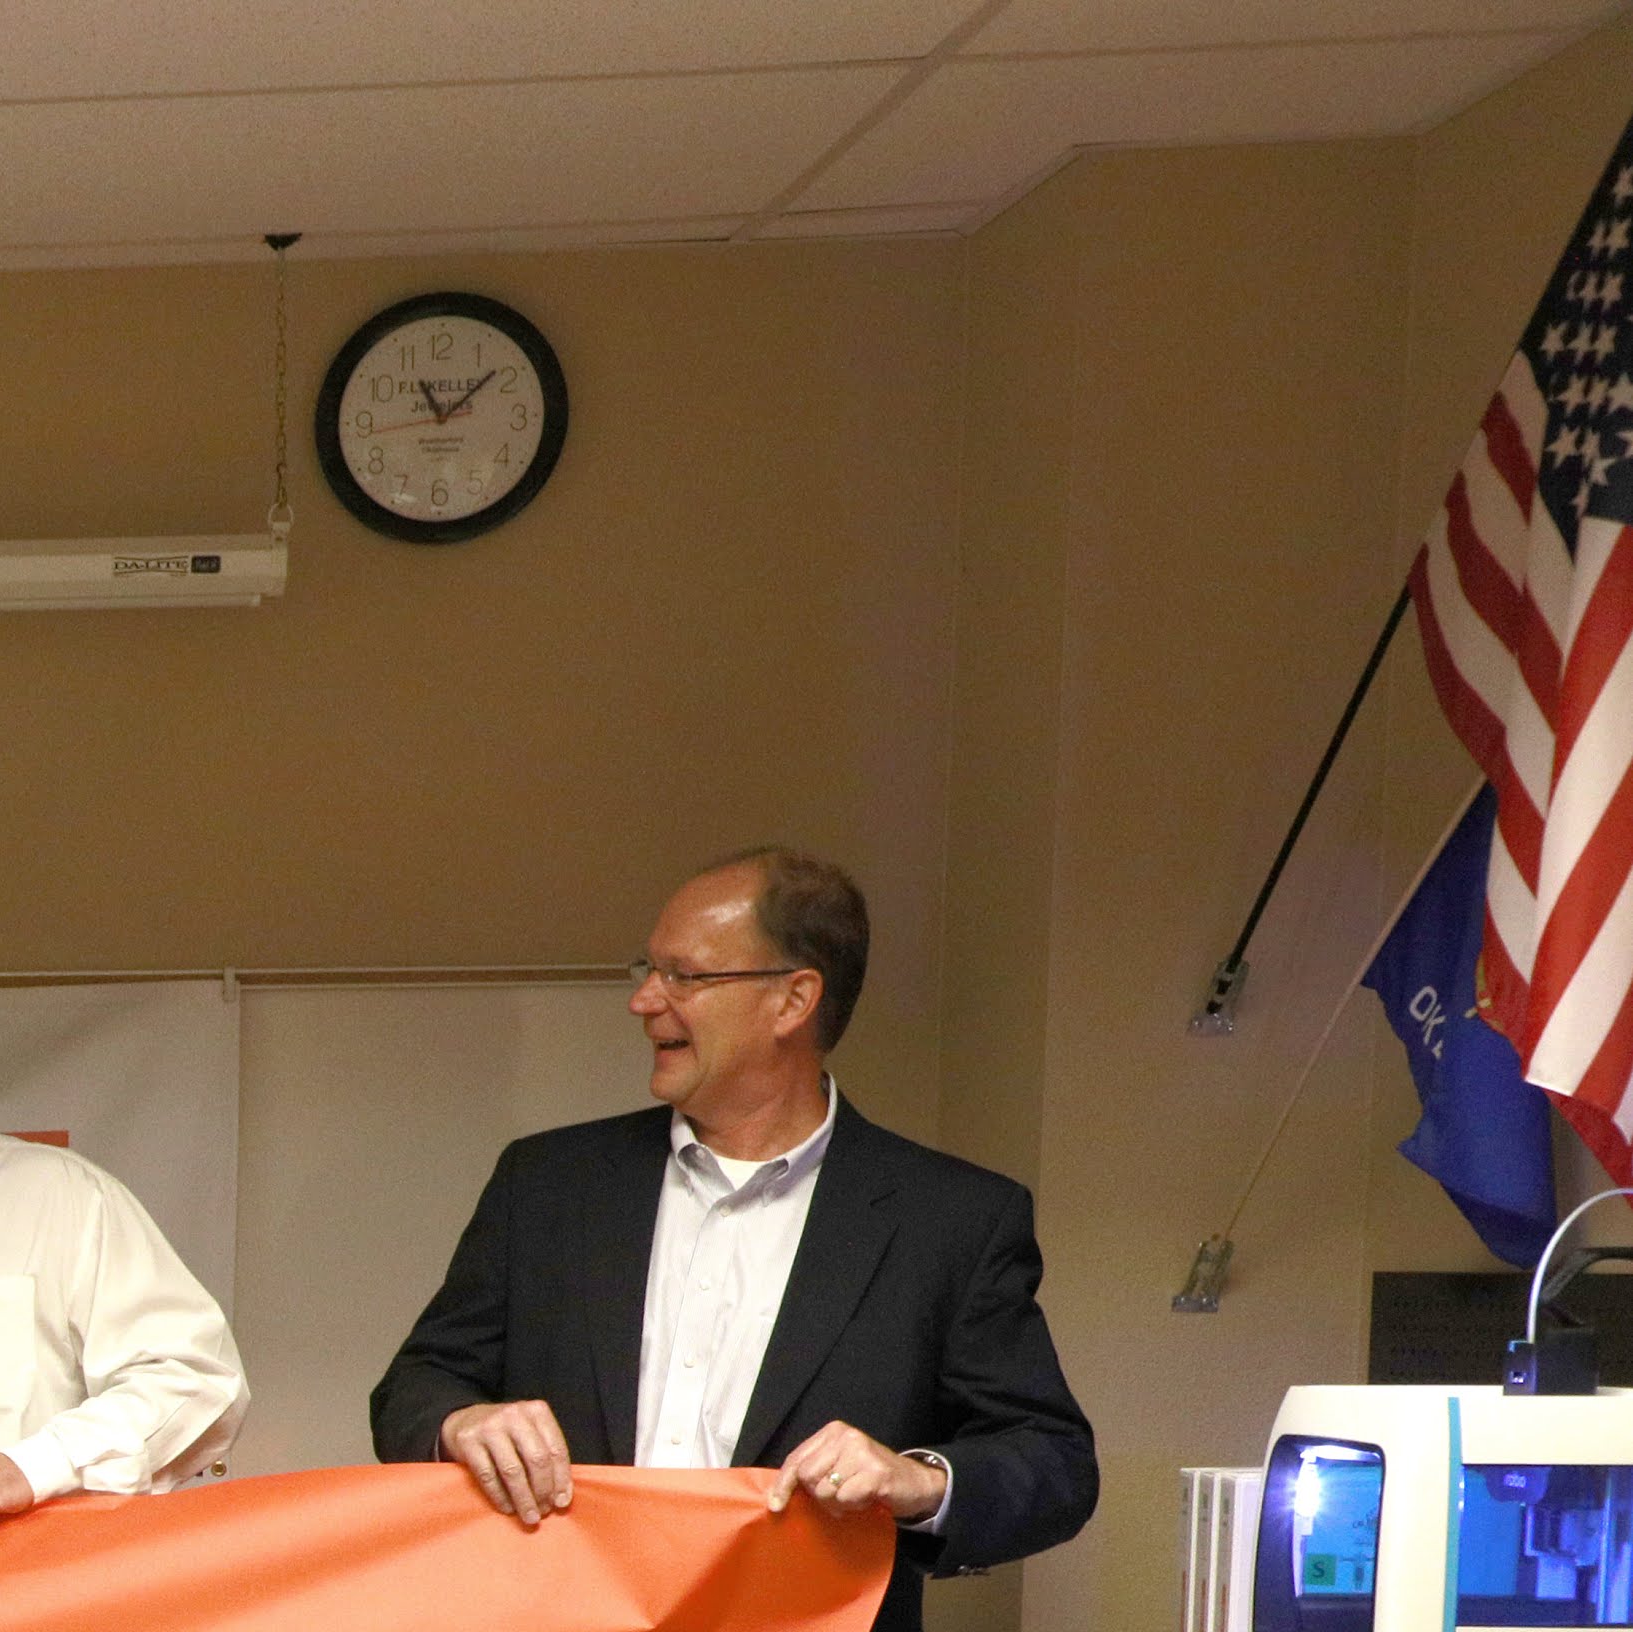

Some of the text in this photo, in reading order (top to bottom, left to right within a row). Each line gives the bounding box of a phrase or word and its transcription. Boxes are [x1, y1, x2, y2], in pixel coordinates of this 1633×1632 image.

[401, 344, 415, 371] 11
[430, 333, 453, 361] 12
[371, 375, 394, 402] 10
[499, 366, 518, 394] 2
[356, 411, 373, 439] 9
[510, 403, 527, 431] 3
[368, 446, 384, 474] 8
[494, 442, 510, 468] 4
[395, 473, 408, 496] 7
[431, 479, 449, 506] 6
[467, 469, 484, 495] 5
